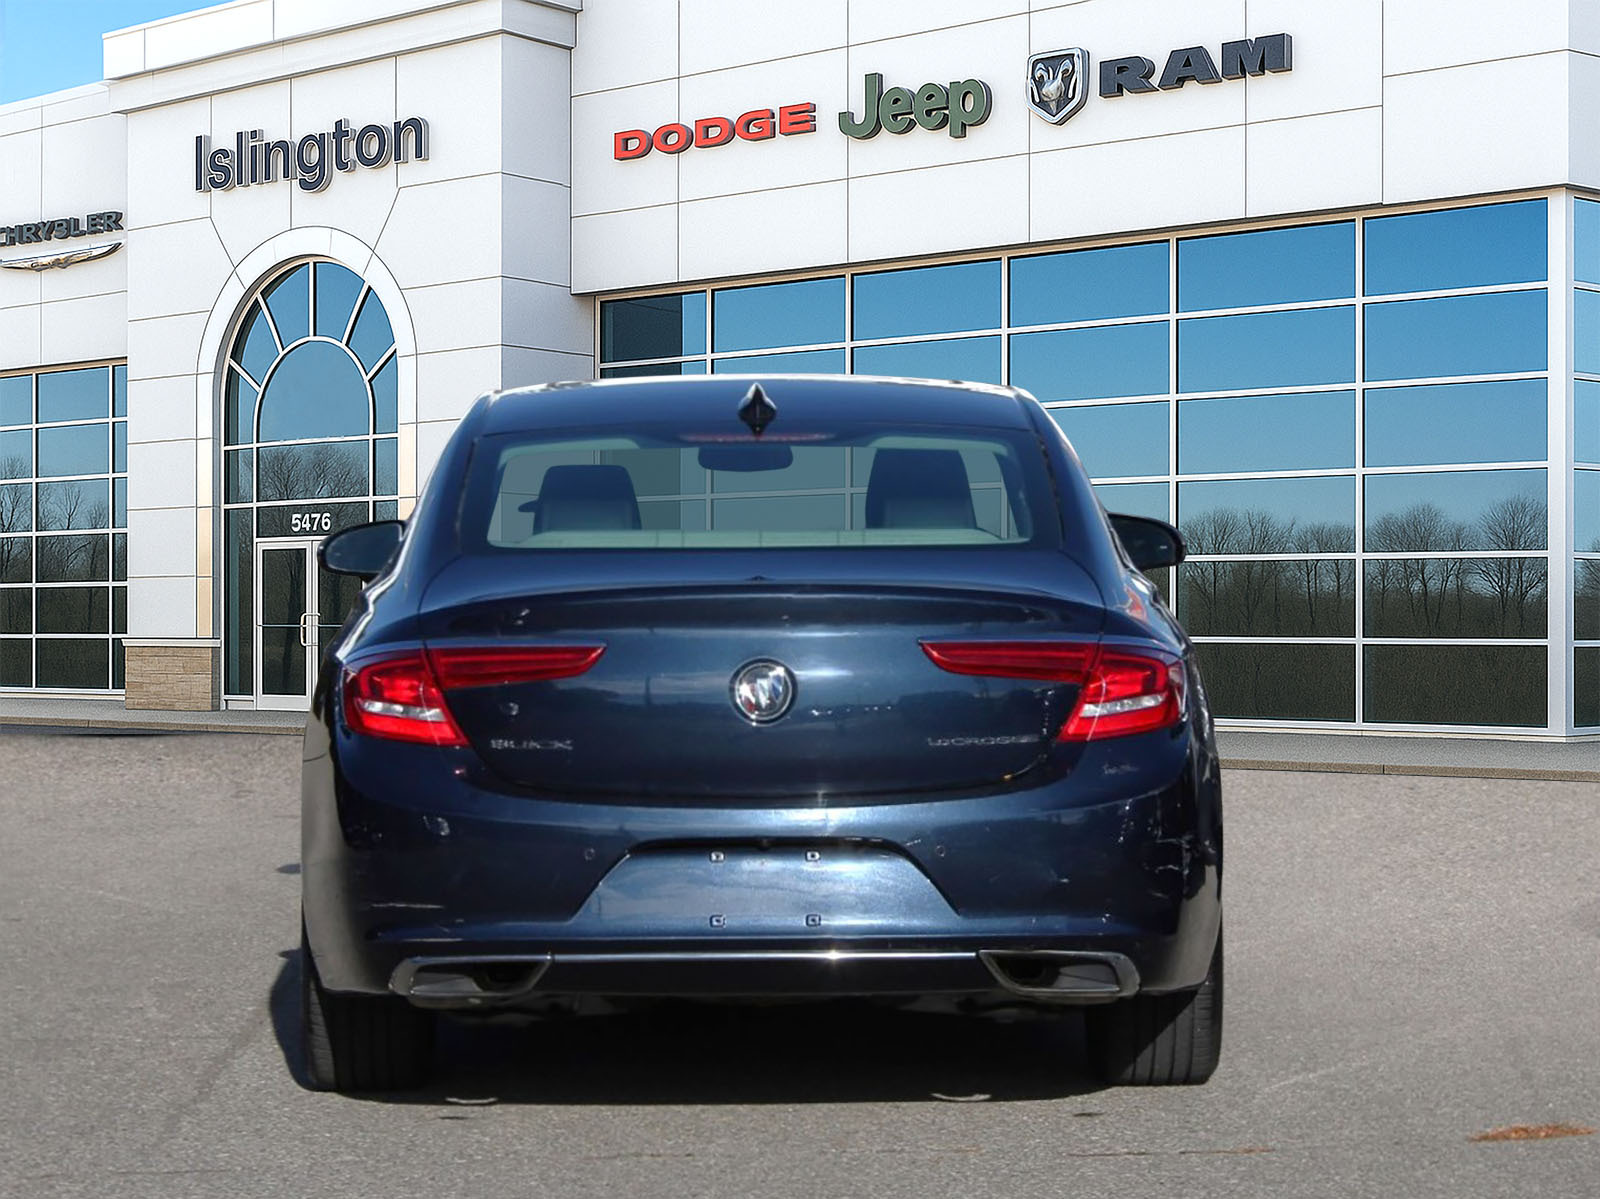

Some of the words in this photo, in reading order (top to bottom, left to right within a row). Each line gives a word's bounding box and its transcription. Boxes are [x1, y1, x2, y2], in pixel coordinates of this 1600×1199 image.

[614, 102, 816, 160] DODGE
[838, 73, 992, 139] Jeep
[1100, 33, 1292, 98] RAM
[195, 116, 429, 192] Islington
[291, 512, 331, 532] 5476
